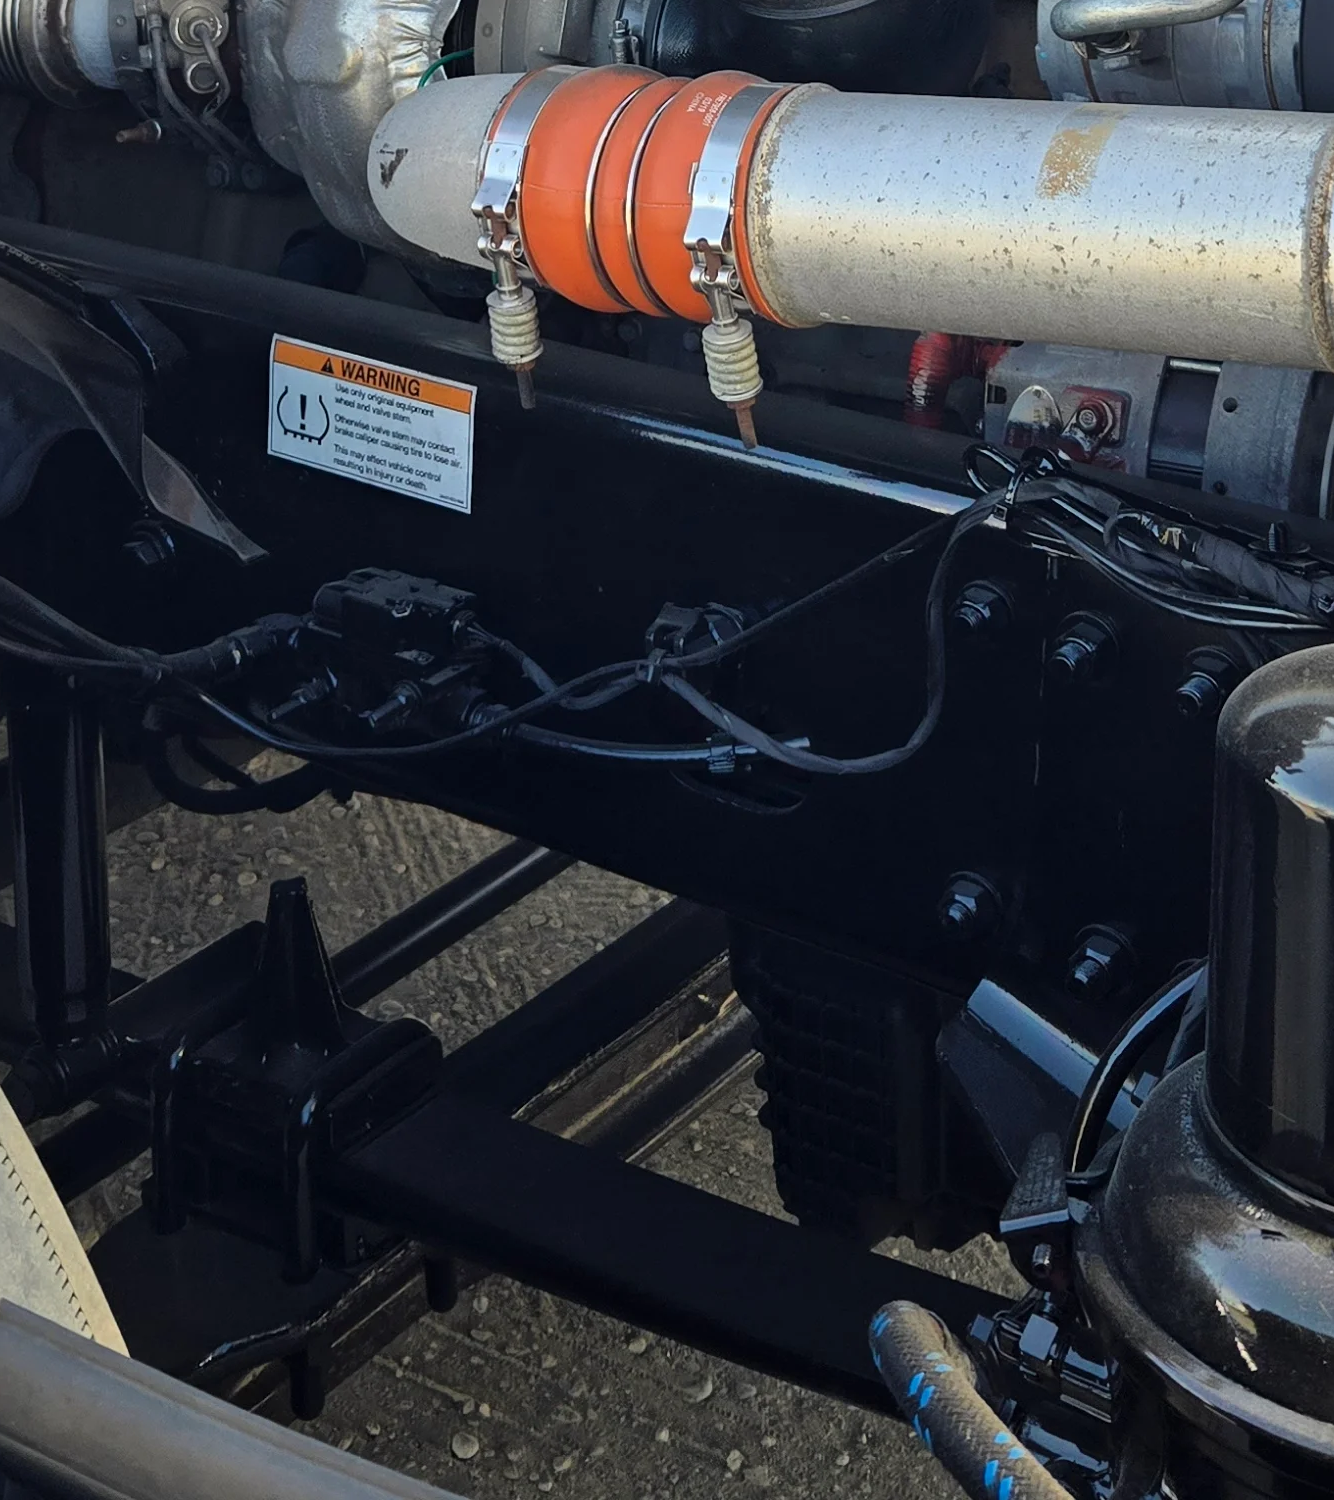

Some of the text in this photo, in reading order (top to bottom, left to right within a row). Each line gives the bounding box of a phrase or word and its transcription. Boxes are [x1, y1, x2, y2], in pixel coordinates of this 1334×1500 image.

[335, 383, 349, 394] Use
[350, 388, 366, 400] only
[367, 392, 394, 407] original
[341, 360, 421, 397] WARNING
[334, 396, 355, 408] wheel
[357, 402, 370, 412] and
[372, 406, 391, 418] valve
[334, 413, 455, 455] Otherwise valve stem may contact
[334, 425, 463, 469] brake caliper causing tire to lose air.
[332, 457, 427, 491] resulting in injury or death.
[333, 443, 349, 455] This
[349, 449, 365, 462] may
[388, 461, 414, 474] vehicle
[415, 469, 441, 482] control
